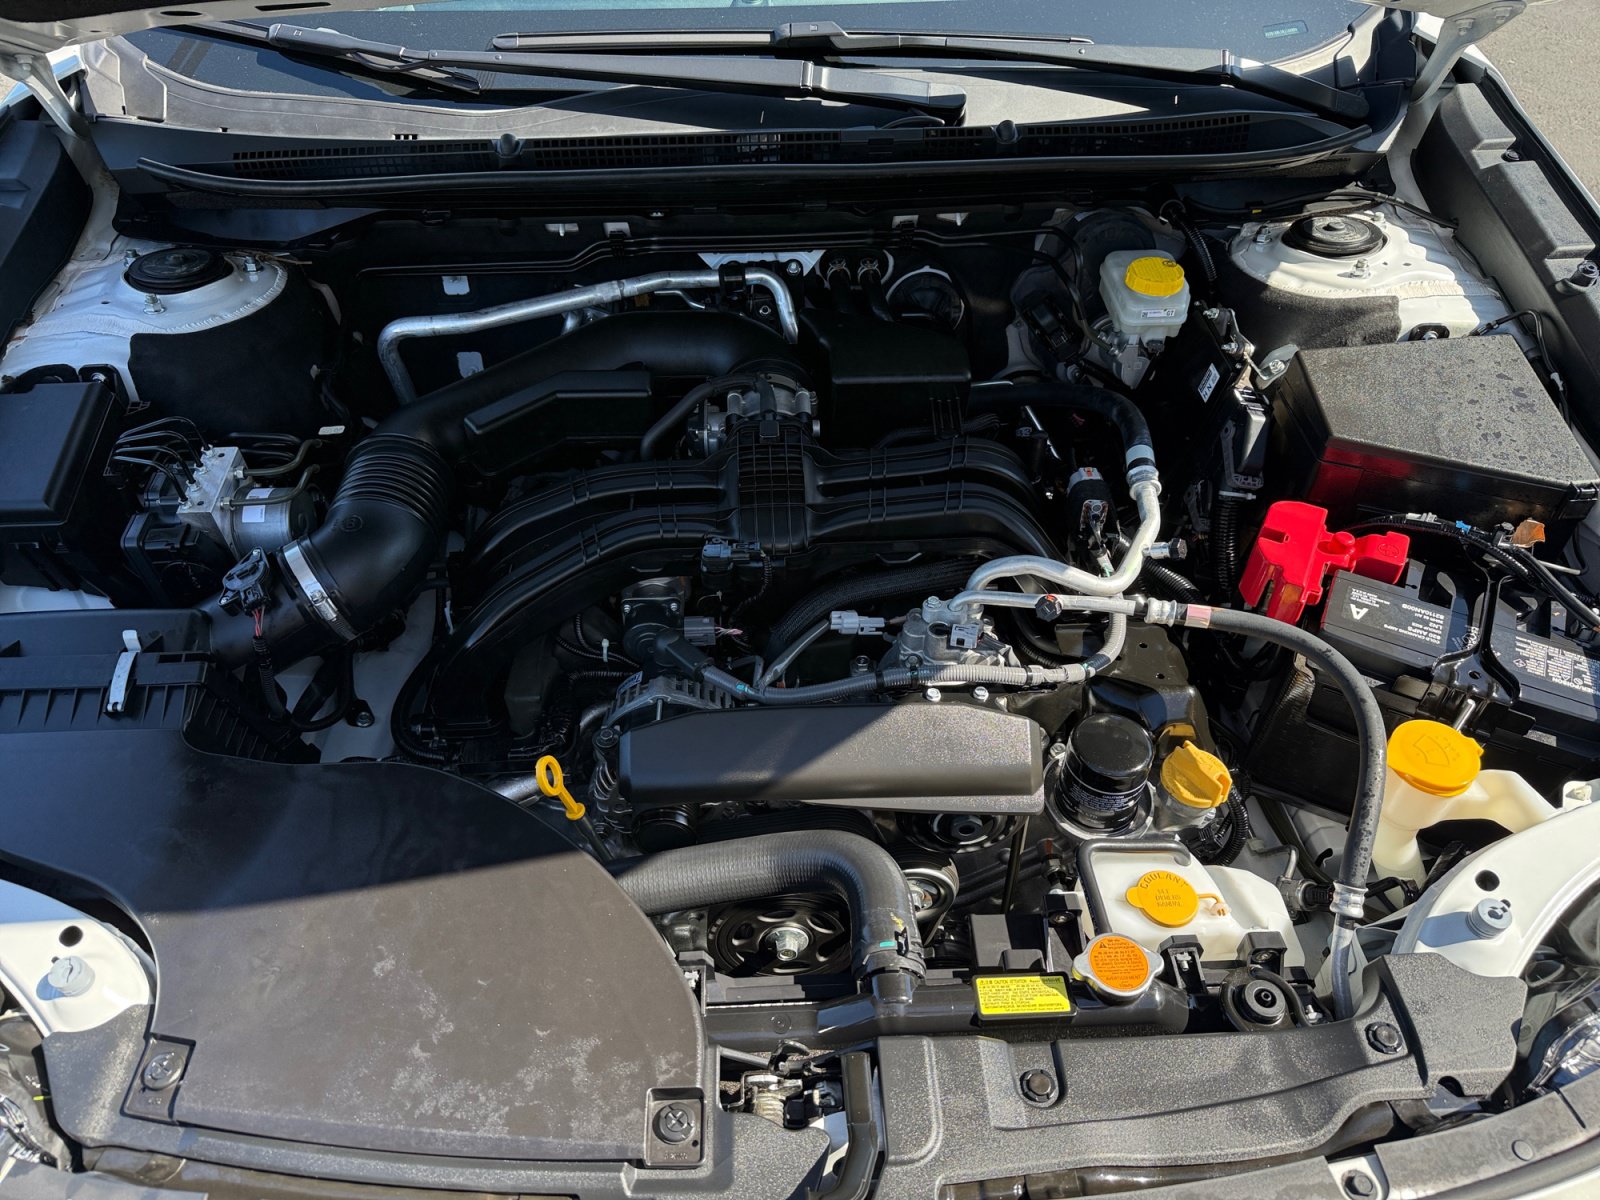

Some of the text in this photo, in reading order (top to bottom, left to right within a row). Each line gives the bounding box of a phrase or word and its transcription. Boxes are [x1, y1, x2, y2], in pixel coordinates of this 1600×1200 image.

[1350, 604, 1368, 620] A
[1408, 626, 1428, 636] AMPS
[1140, 872, 1189, 889] COOLANT
